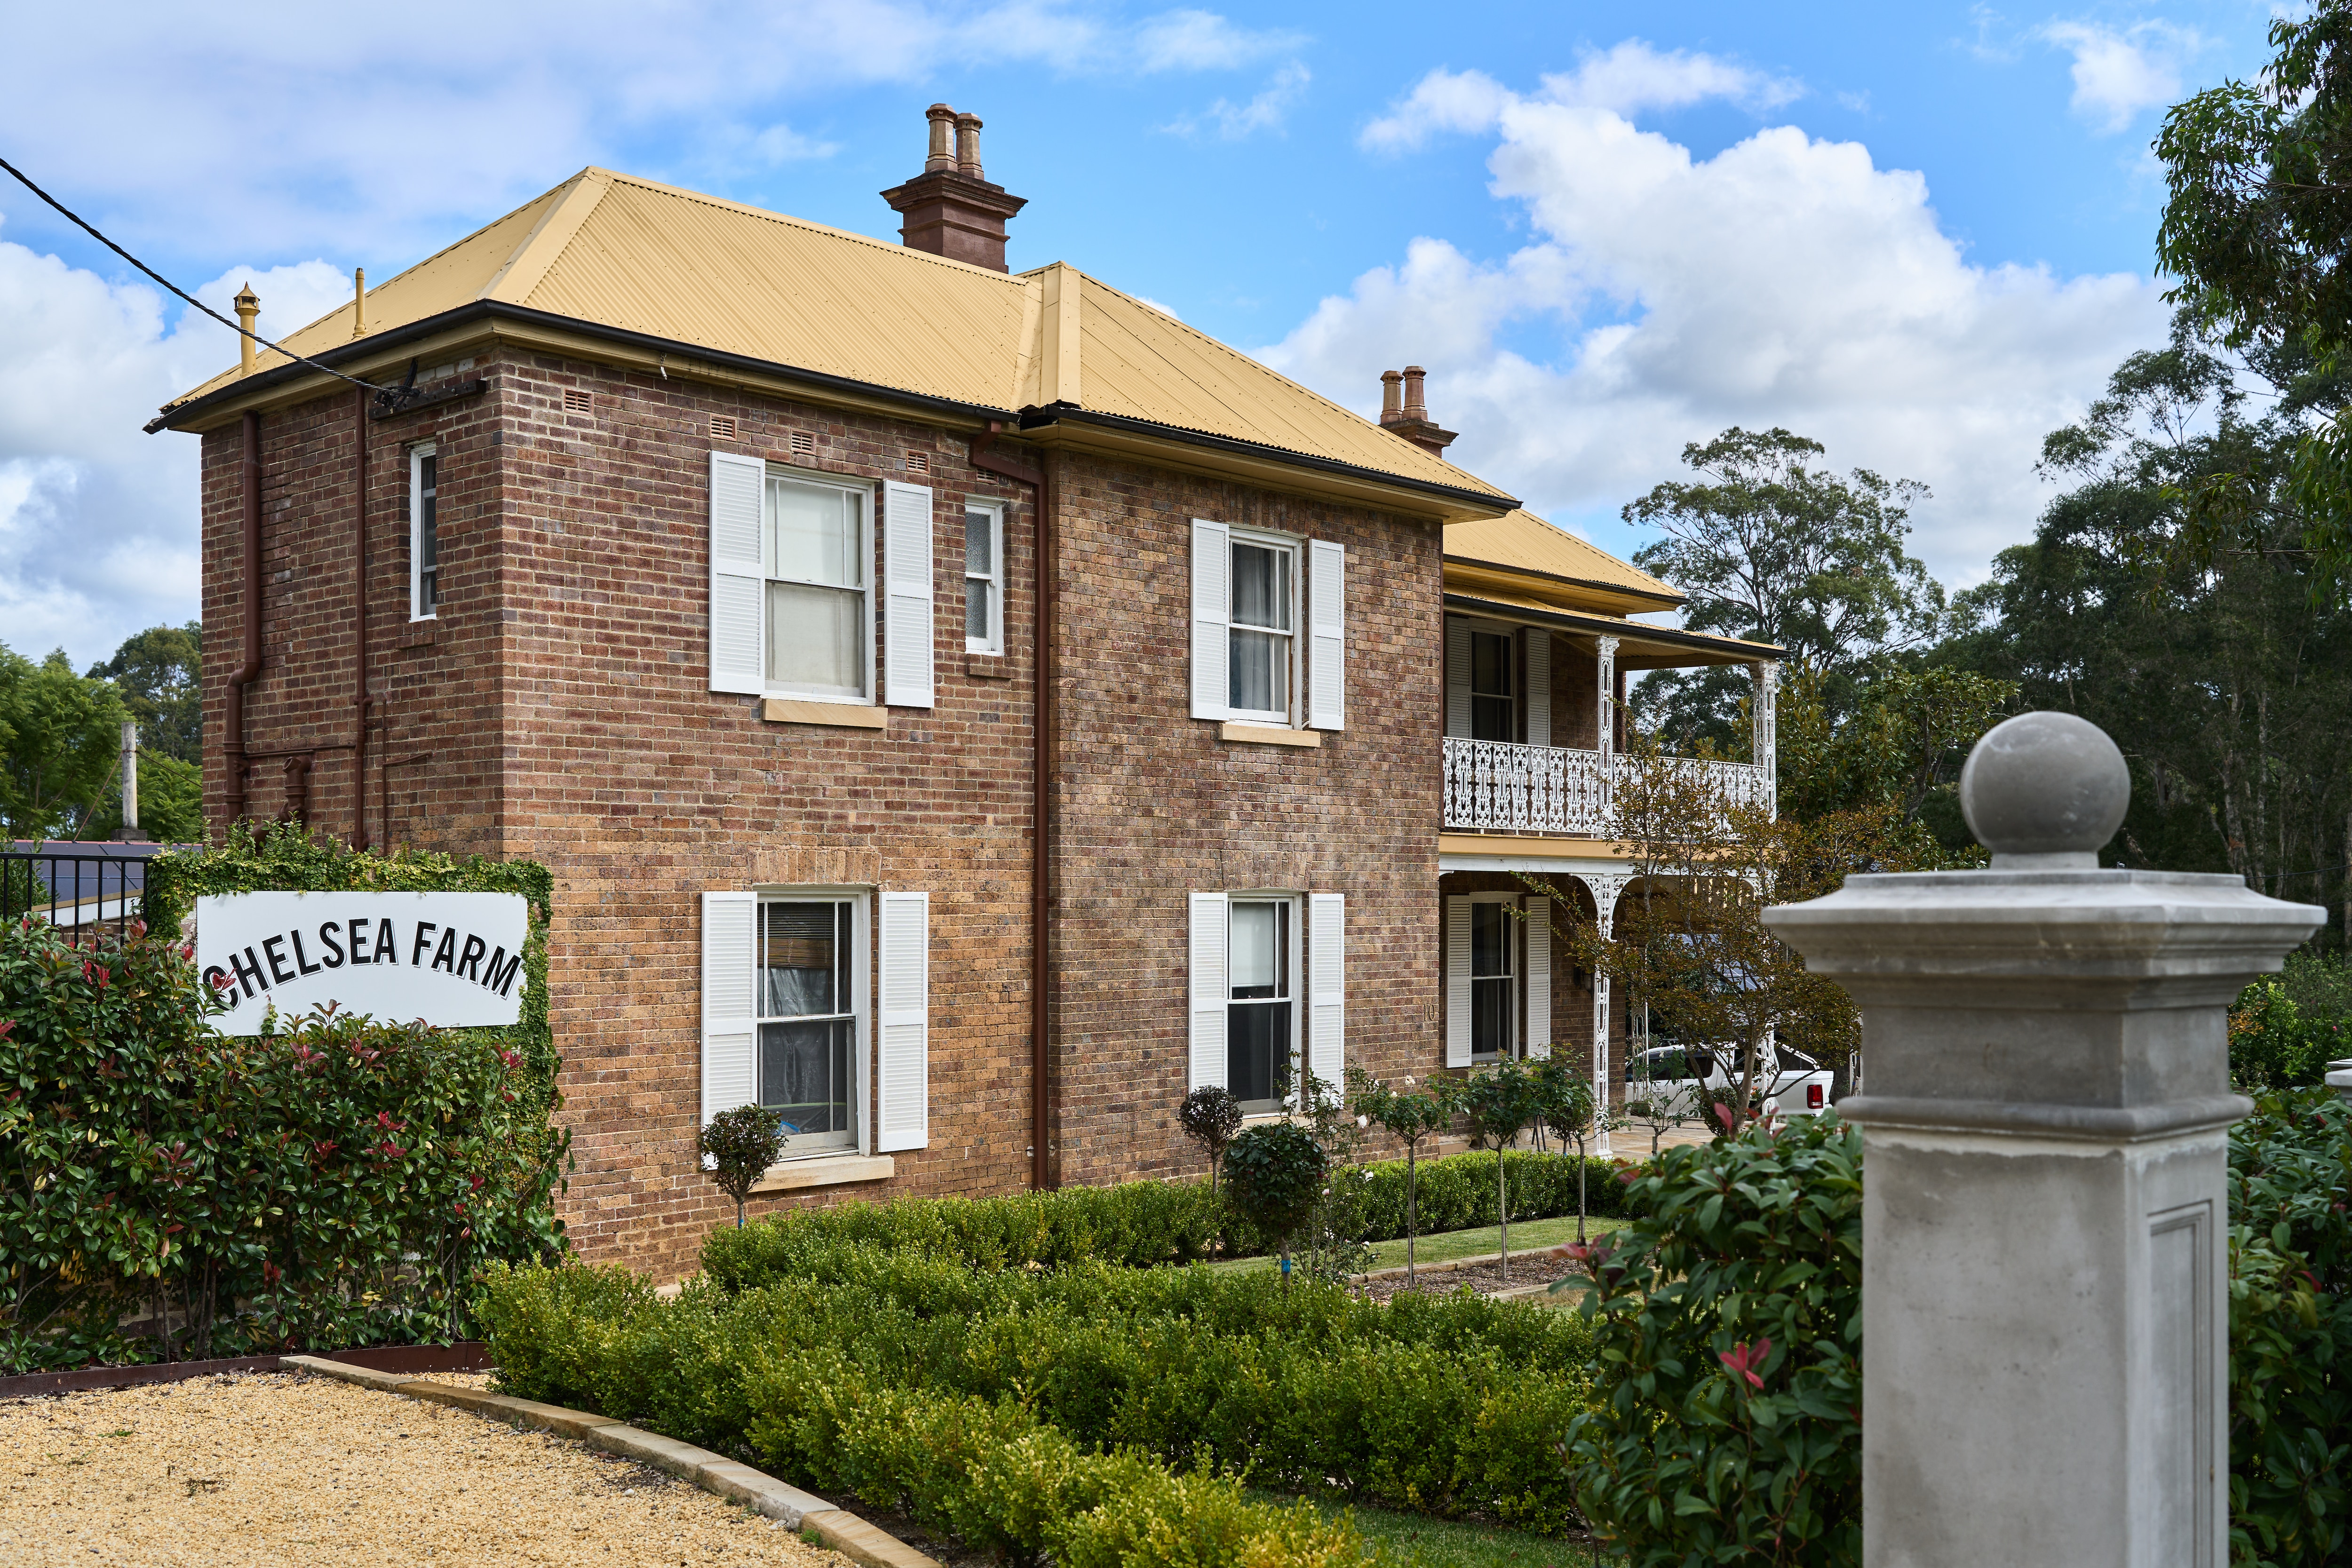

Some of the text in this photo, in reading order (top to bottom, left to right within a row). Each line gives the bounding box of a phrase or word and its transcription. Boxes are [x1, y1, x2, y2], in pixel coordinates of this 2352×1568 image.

[202, 918, 522, 1011] CHELSEA FARM
[1424, 1003, 1435, 1021] 10
